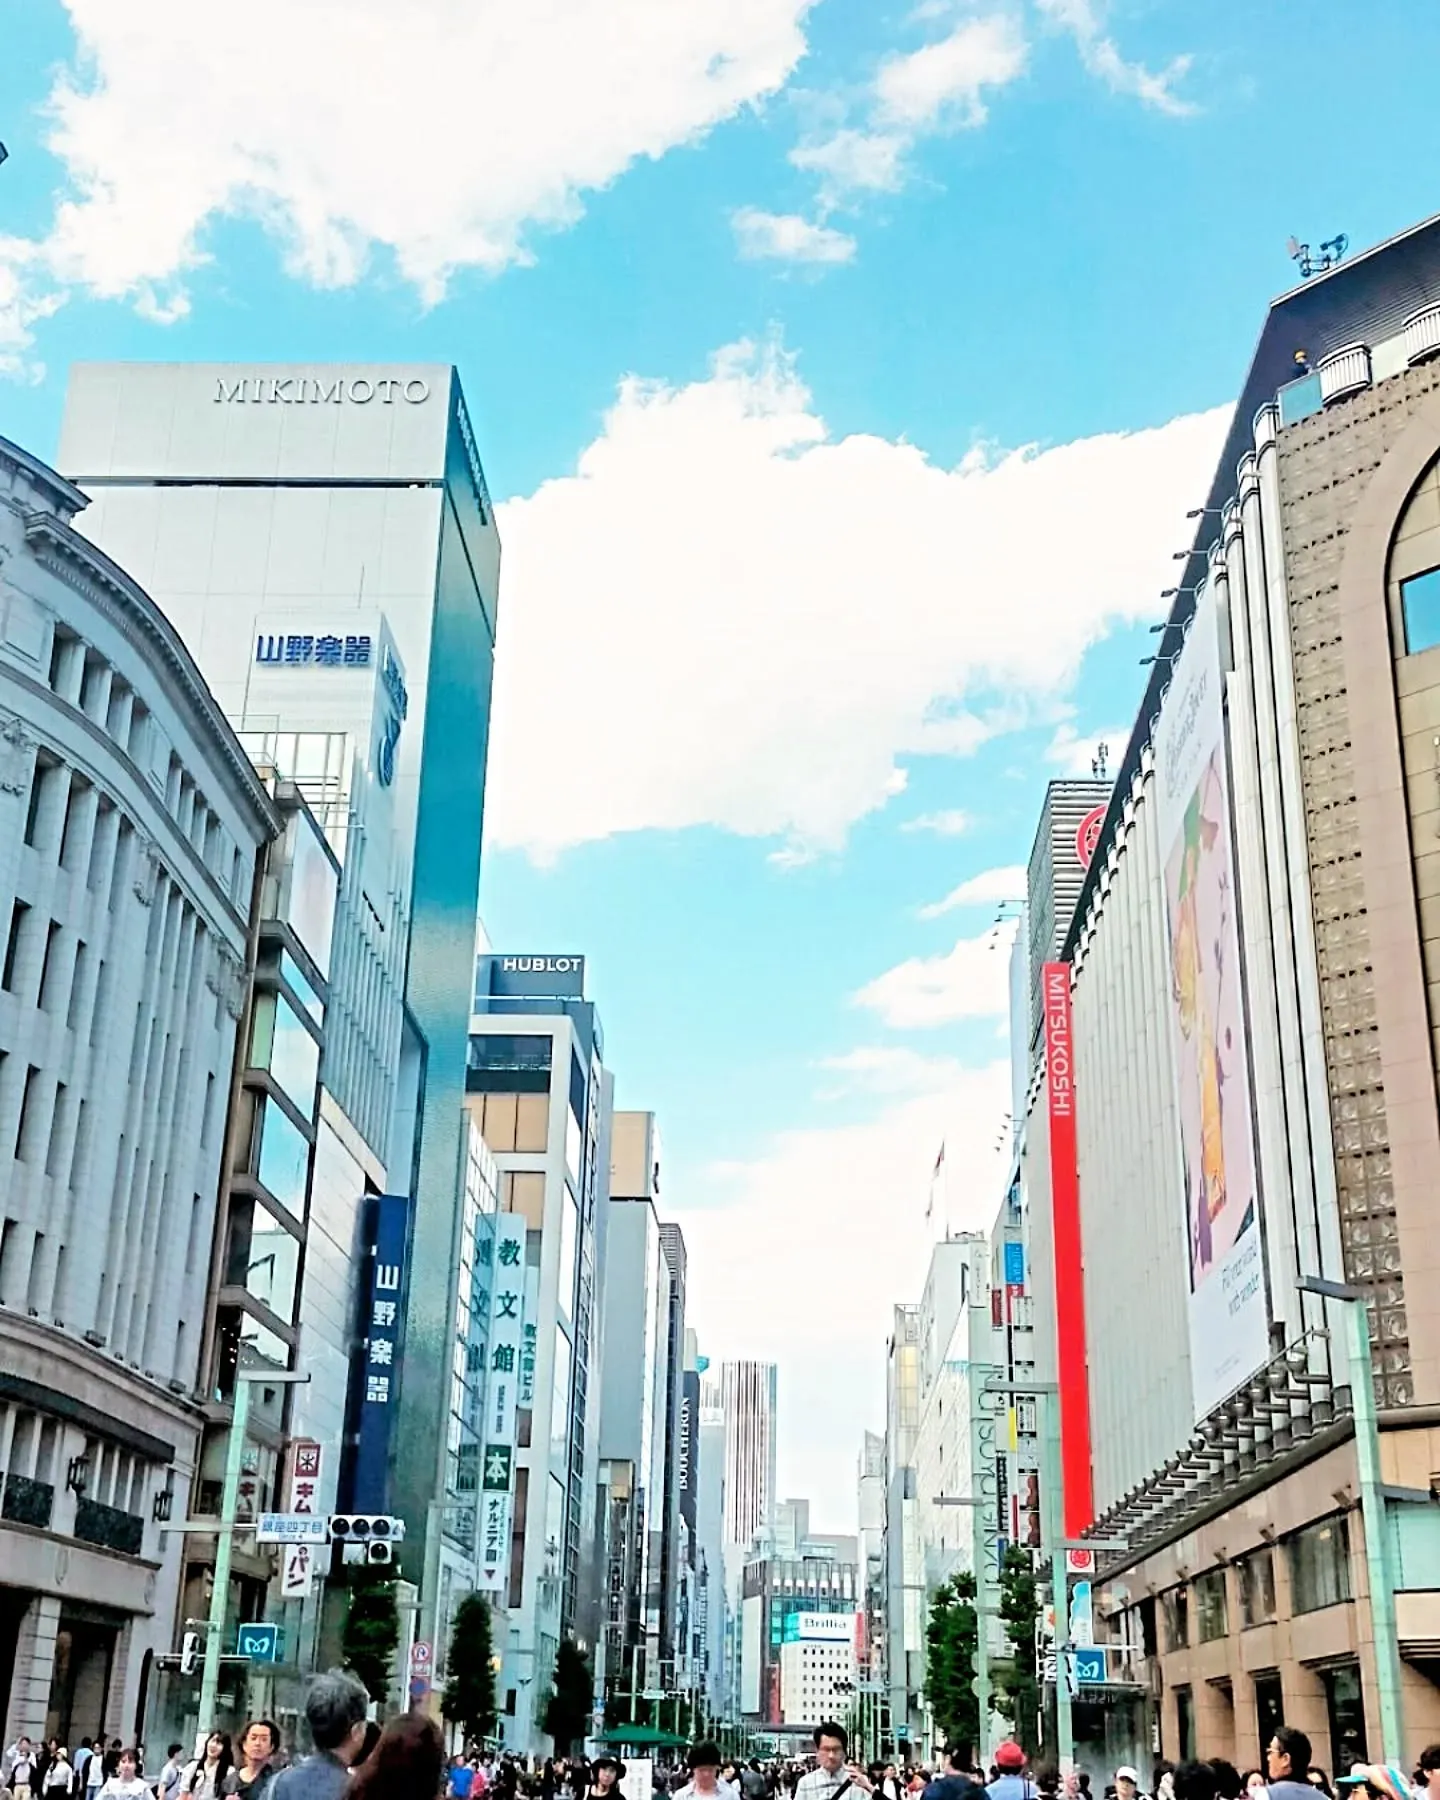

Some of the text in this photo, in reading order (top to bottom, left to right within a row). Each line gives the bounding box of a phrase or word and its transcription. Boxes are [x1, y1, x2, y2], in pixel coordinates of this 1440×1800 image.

[214, 379, 430, 404] MIKIMOTO
[256, 635, 371, 665] 山野楽器
[503, 957, 582, 973] HUBLOT
[1049, 974, 1070, 1115] MITSUKOSHI
[492, 1237, 520, 1373] 教文館
[366, 1265, 399, 1403] 山野楽器
[679, 1396, 690, 1491] BOUCHERON
[485, 1451, 508, 1484] 本
[805, 1618, 846, 1629] Brillia
